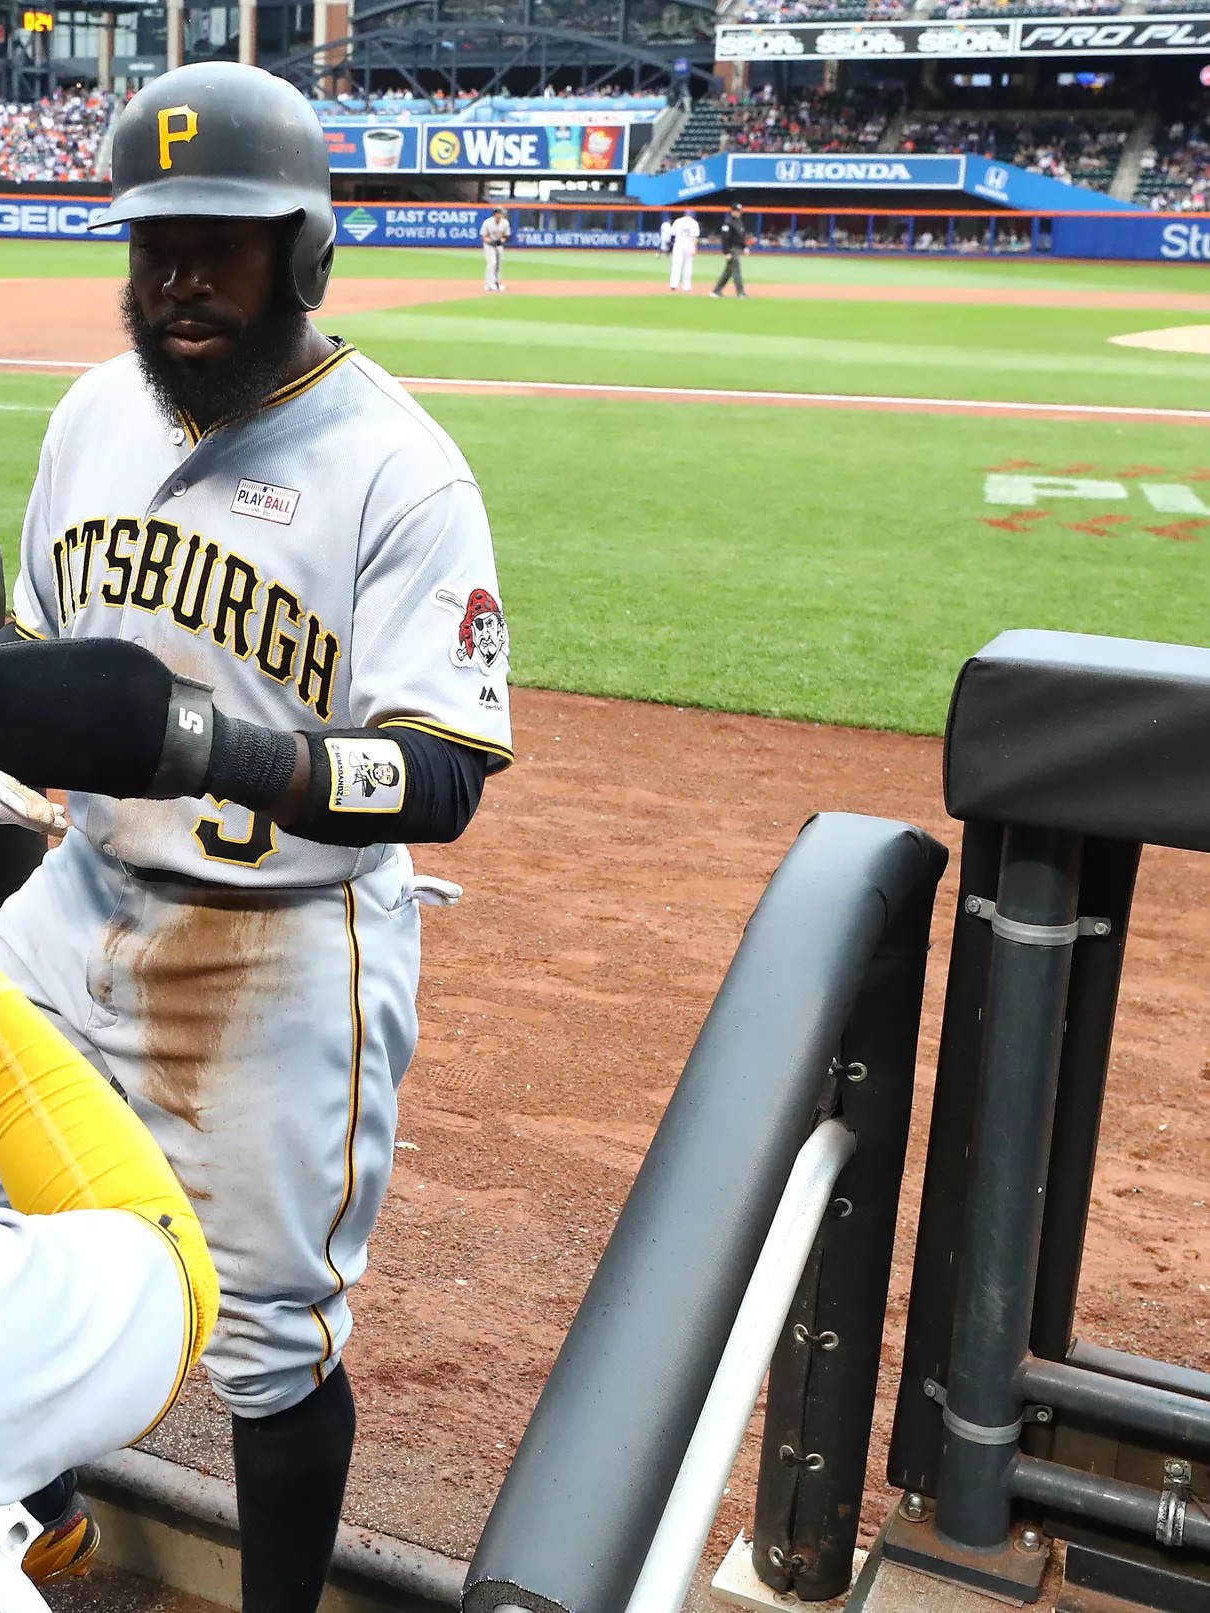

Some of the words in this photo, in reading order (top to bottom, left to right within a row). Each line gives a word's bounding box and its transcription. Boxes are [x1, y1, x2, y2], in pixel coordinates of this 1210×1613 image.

[1022, 25, 1136, 48] PRO
[157, 104, 199, 170] P
[801, 162, 912, 181] HONDA
[385, 210, 425, 224] EAST
[427, 210, 478, 224] COAST
[385, 226, 436, 238] POWER
[438, 227, 446, 238] &
[449, 226, 478, 239] GAS
[525, 232, 554, 245] MLB
[555, 232, 619, 246] NETWORK
[637, 231, 661, 247] 370
[237, 489, 265, 507] PLAY
[264, 495, 290, 514] BALL
[52, 515, 342, 724] ITTSBURGH
